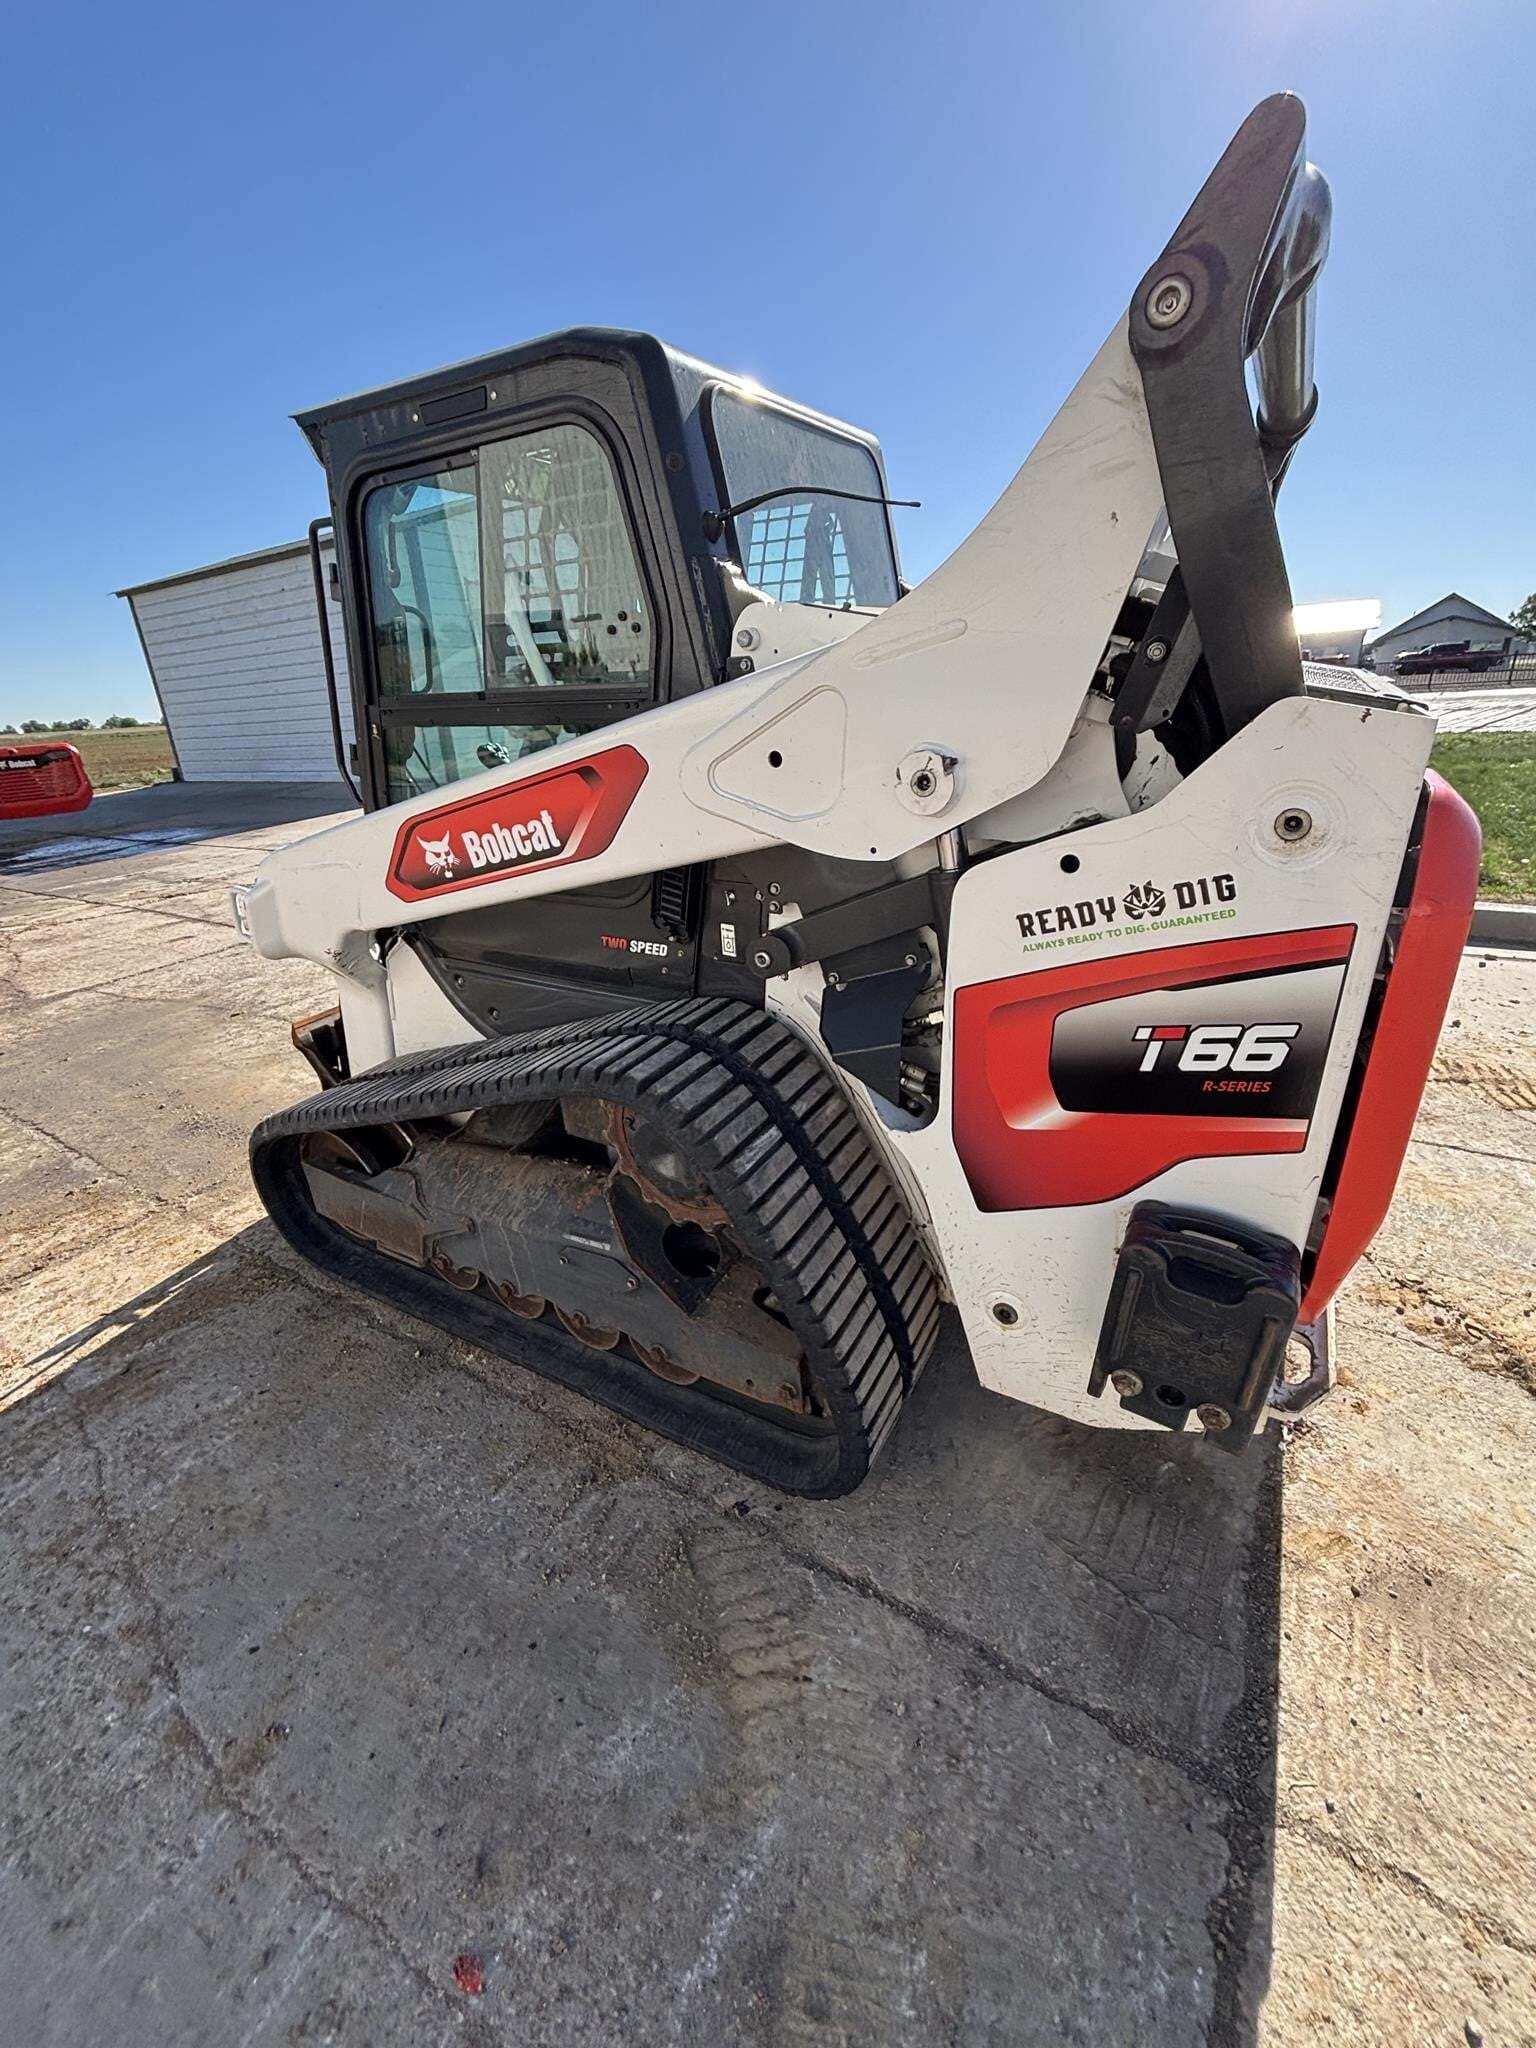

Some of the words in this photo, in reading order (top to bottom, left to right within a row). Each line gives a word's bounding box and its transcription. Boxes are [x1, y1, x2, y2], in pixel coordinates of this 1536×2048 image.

[461, 809, 561, 868] Bobcat
[1016, 896, 1116, 938] READY
[1173, 873, 1237, 909] DIG
[601, 936, 628, 950] TWO
[629, 940, 668, 957] SPEED
[1022, 938, 1065, 953] ALWAYS
[1067, 931, 1103, 945] READY
[1106, 928, 1122, 938] TO
[1133, 1024, 1301, 1072] T66
[1202, 1080, 1273, 1093] R-SERIES
